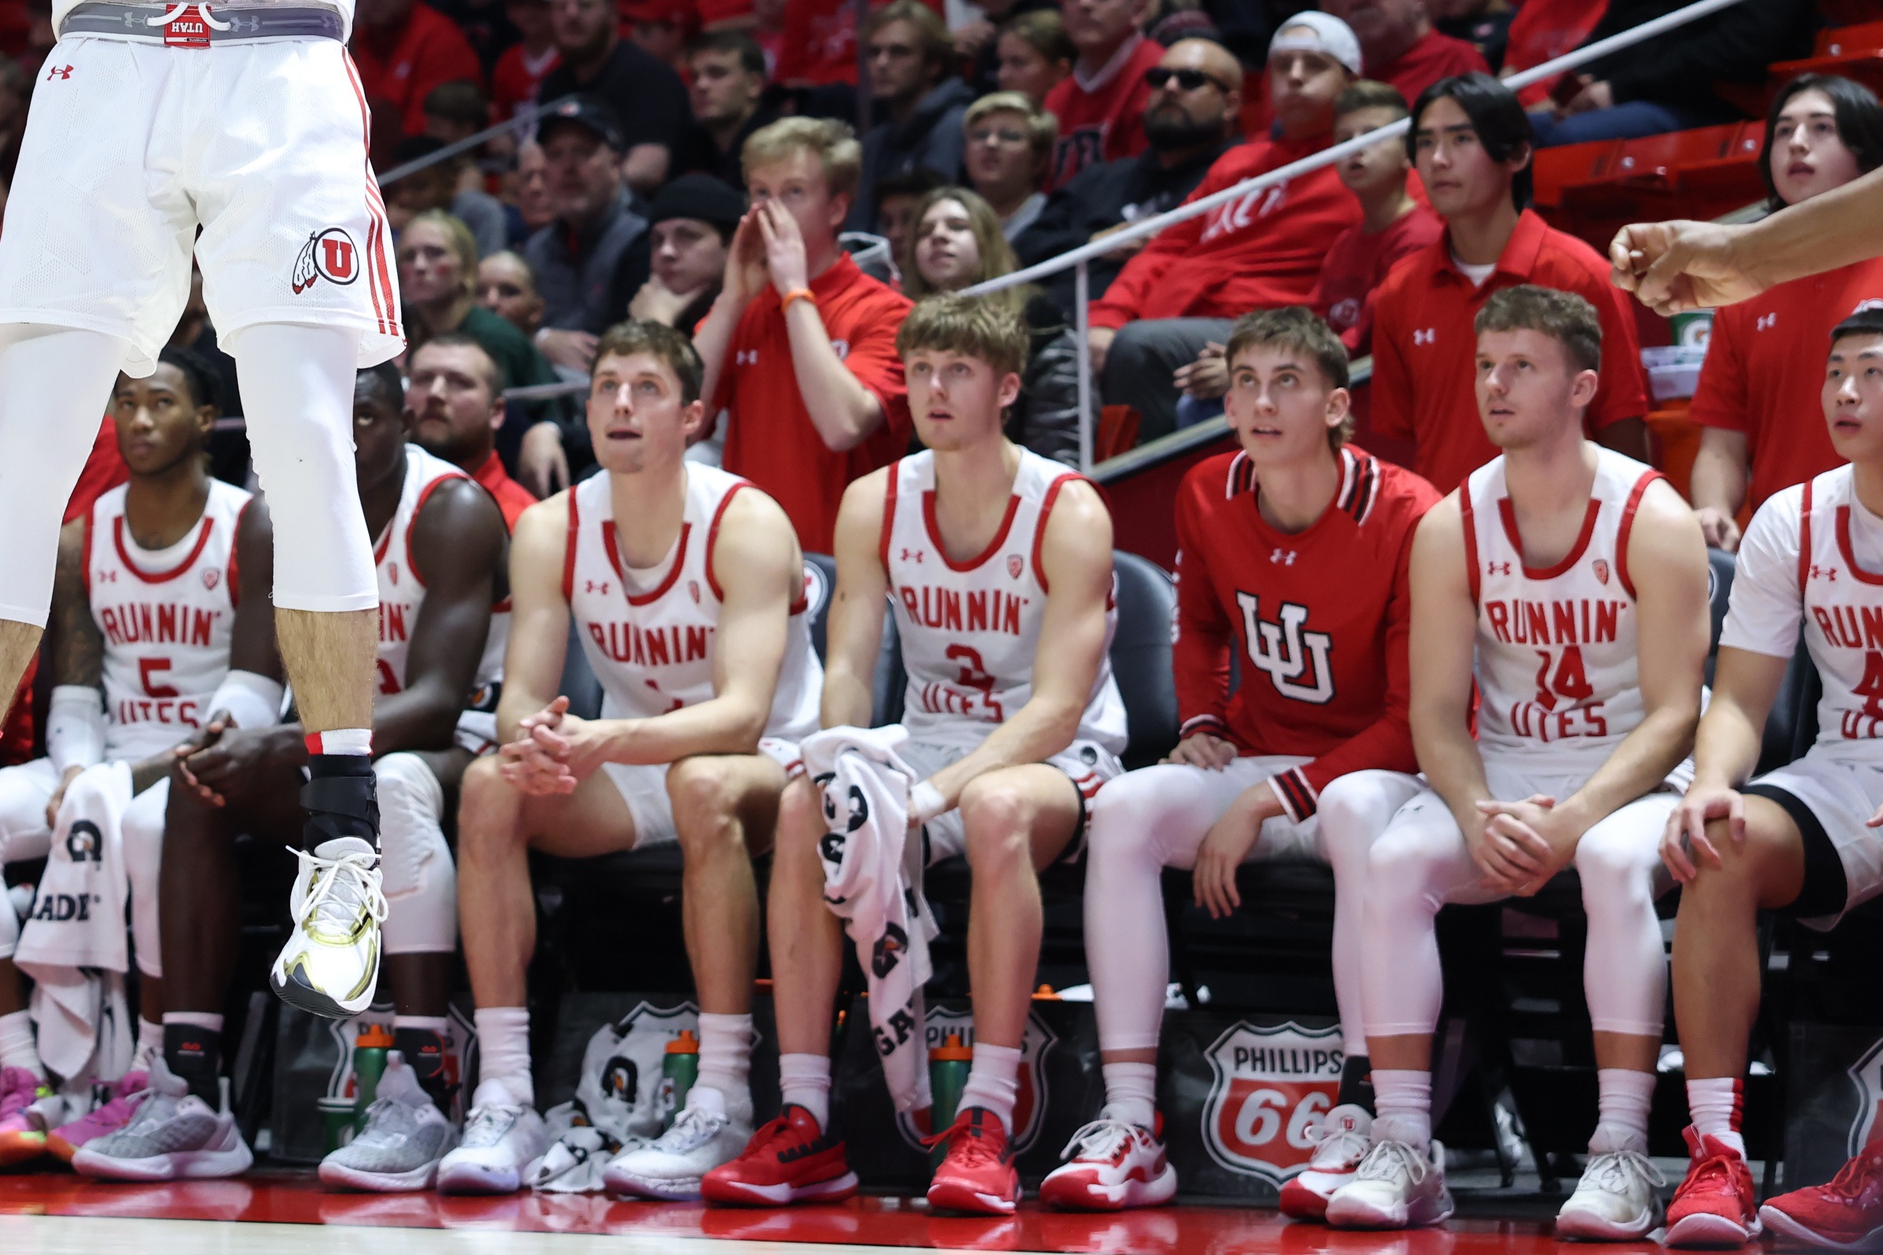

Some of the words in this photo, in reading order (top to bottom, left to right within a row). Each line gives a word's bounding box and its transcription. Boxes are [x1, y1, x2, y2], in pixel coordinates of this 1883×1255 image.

[171, 22, 203, 33] UTAH
[322, 239, 352, 278] U
[101, 602, 221, 644] RUNNIN'
[900, 586, 1029, 635] RUNNIN'
[1485, 599, 1626, 645] RUNNIN'
[139, 658, 178, 697] 5
[1234, 1046, 1344, 1075] PHILLIPS
[1234, 1088, 1331, 1149] 66
